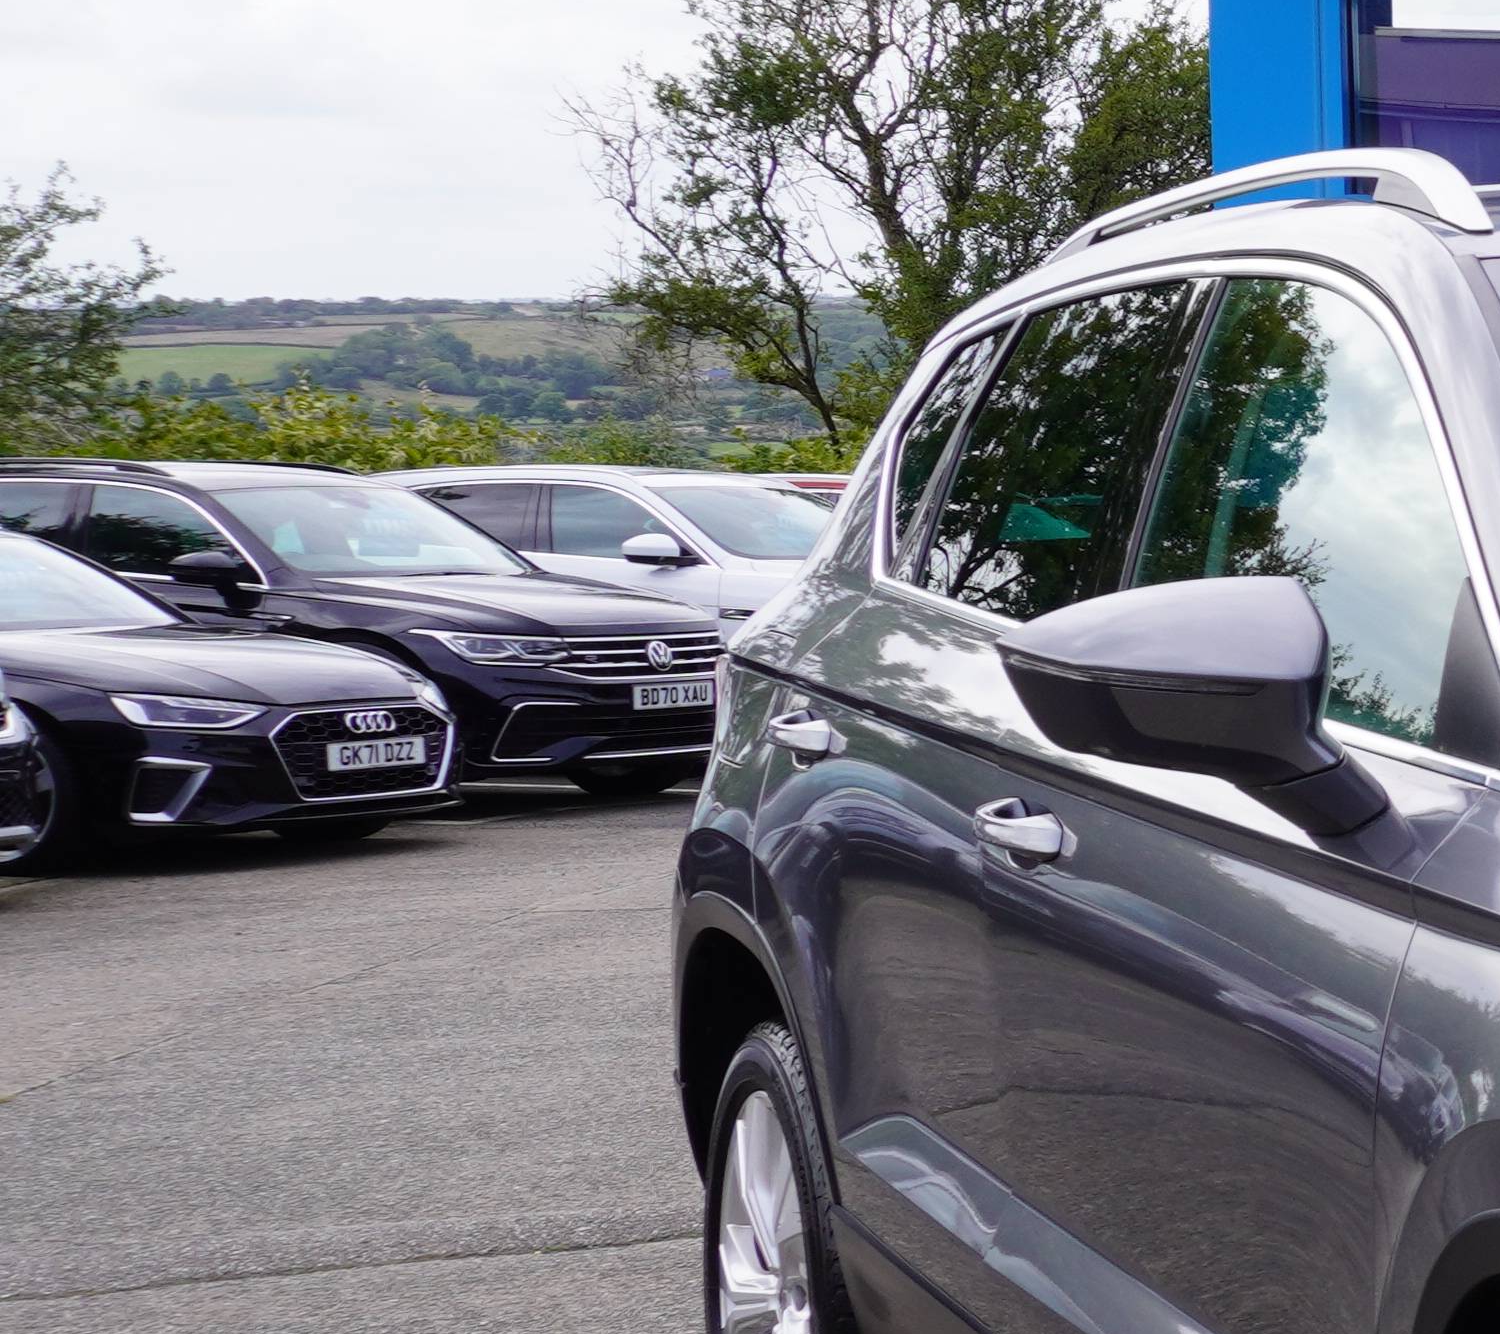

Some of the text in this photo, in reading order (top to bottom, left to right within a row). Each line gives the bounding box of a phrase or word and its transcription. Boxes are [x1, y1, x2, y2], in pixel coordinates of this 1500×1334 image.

[640, 681, 708, 706] BD70 XAU
[339, 736, 415, 765] GK71 DZZ
